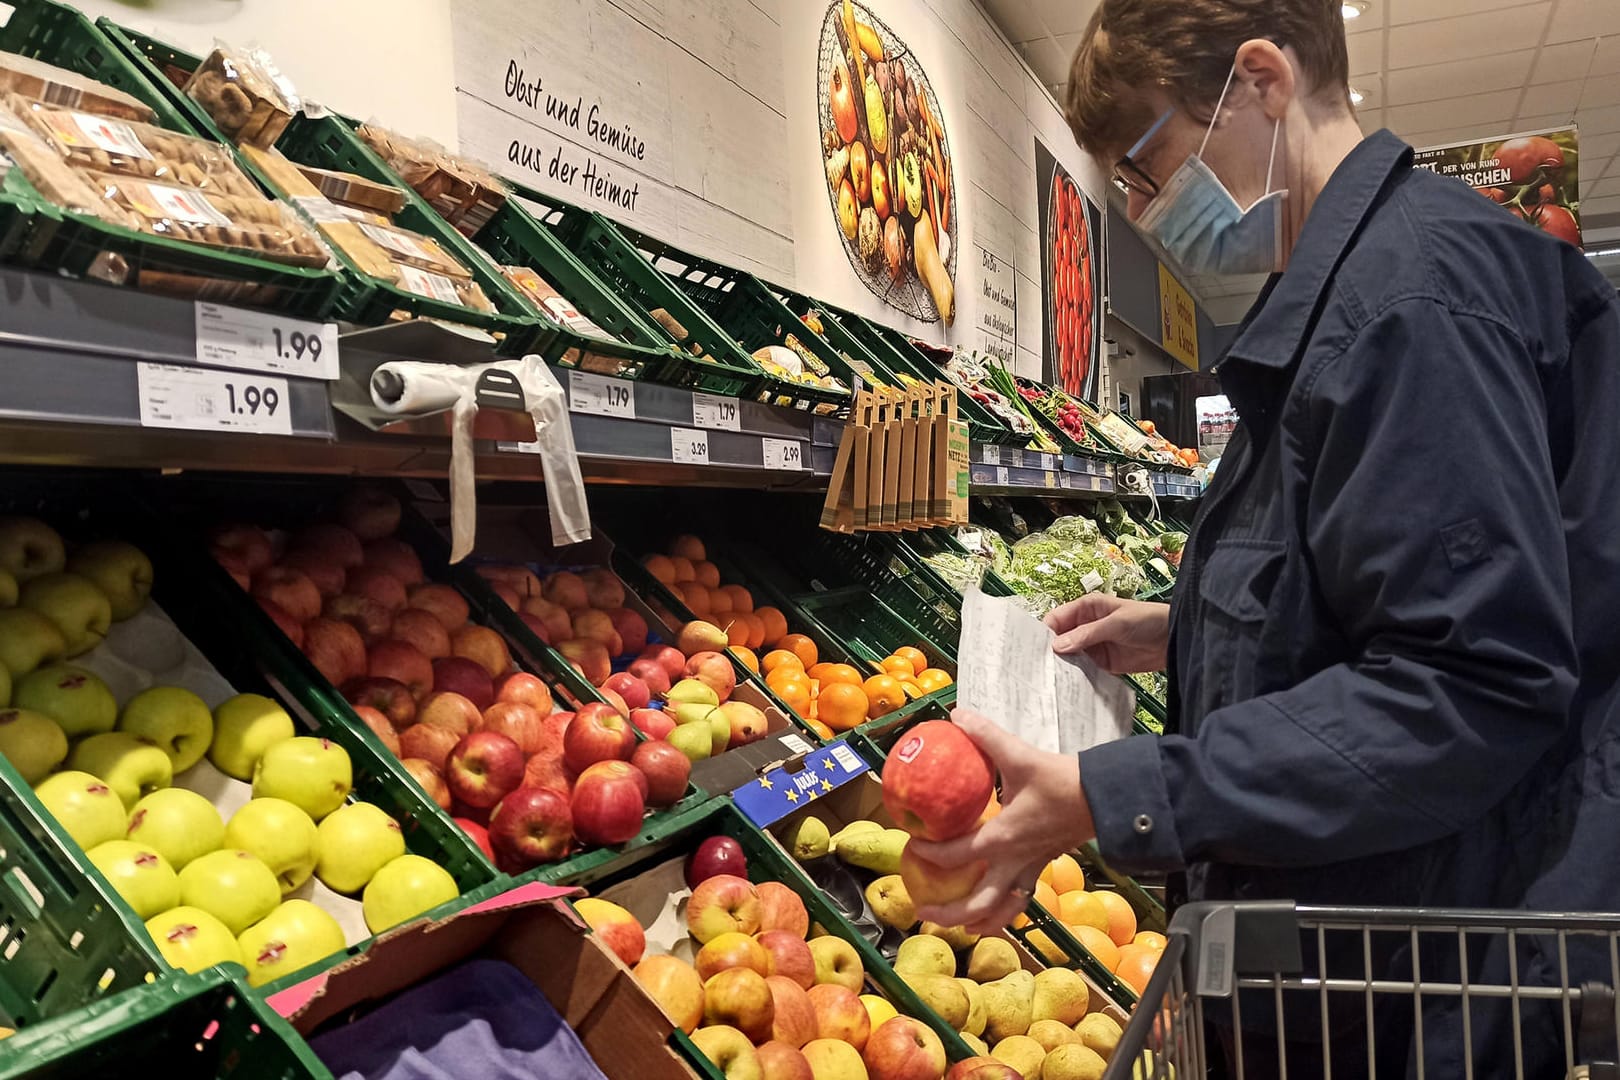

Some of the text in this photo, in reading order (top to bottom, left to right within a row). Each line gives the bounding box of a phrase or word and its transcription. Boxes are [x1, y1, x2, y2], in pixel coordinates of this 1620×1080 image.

[505, 58, 647, 162] Obst und Gemüse
[508, 139, 640, 212] aus der Heimat
[1442, 164, 1458, 174] DER
[1460, 161, 1477, 171] VON
[1479, 158, 1500, 169] RUND
[272, 327, 322, 363] 1.99
[224, 383, 279, 417] 1.99
[606, 384, 630, 408] 1.79
[718, 402, 736, 421] 1.79
[690, 441, 707, 457] 3.29
[783, 446, 800, 463] 2.99
